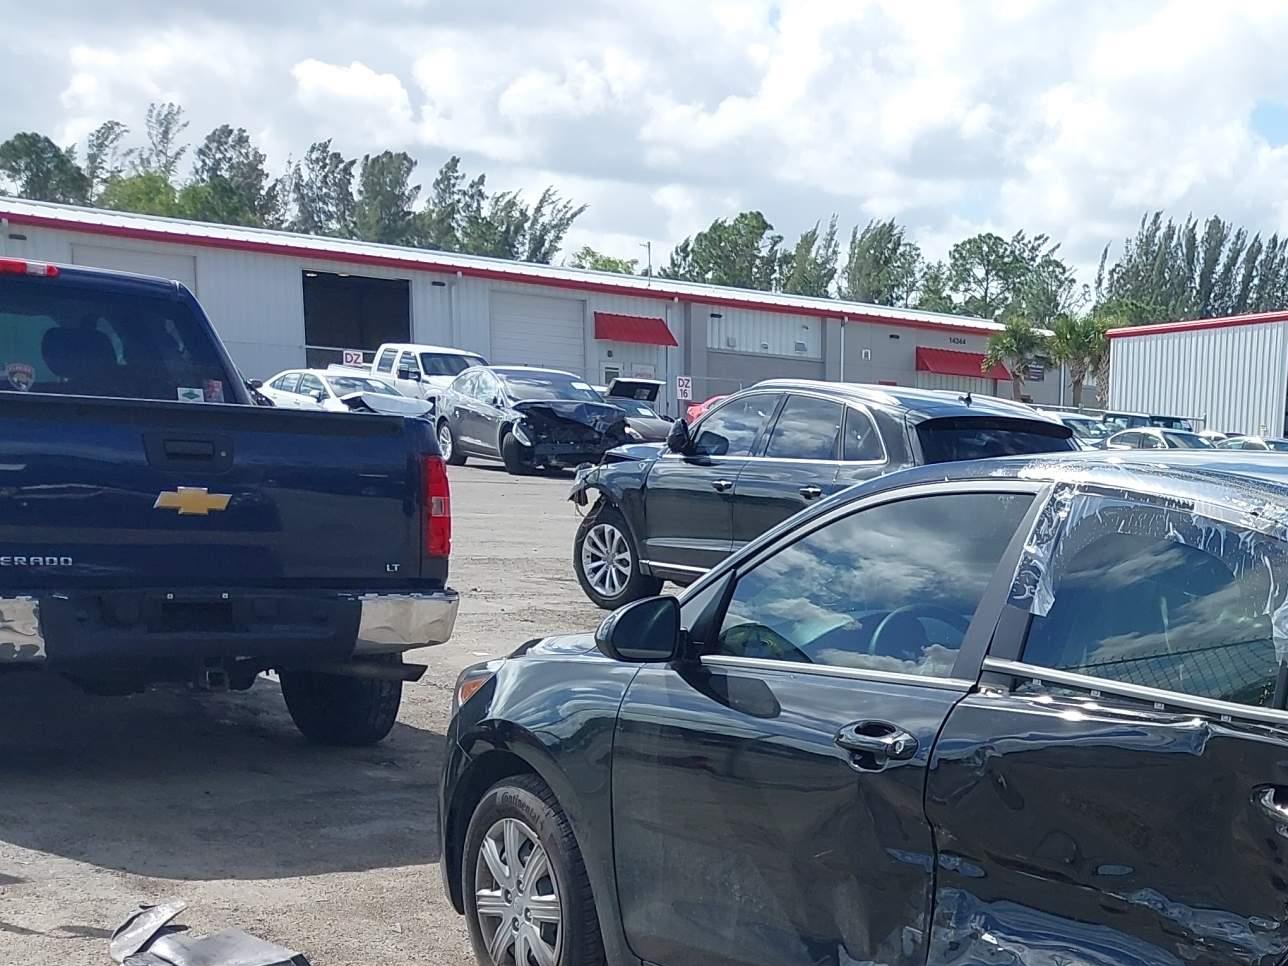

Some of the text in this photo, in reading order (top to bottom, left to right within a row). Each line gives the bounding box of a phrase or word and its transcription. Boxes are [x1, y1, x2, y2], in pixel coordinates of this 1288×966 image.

[345, 352, 361, 364] DZ
[678, 378, 690, 388] DZ
[680, 389, 688, 398] 16
[386, 563, 400, 572] LT
